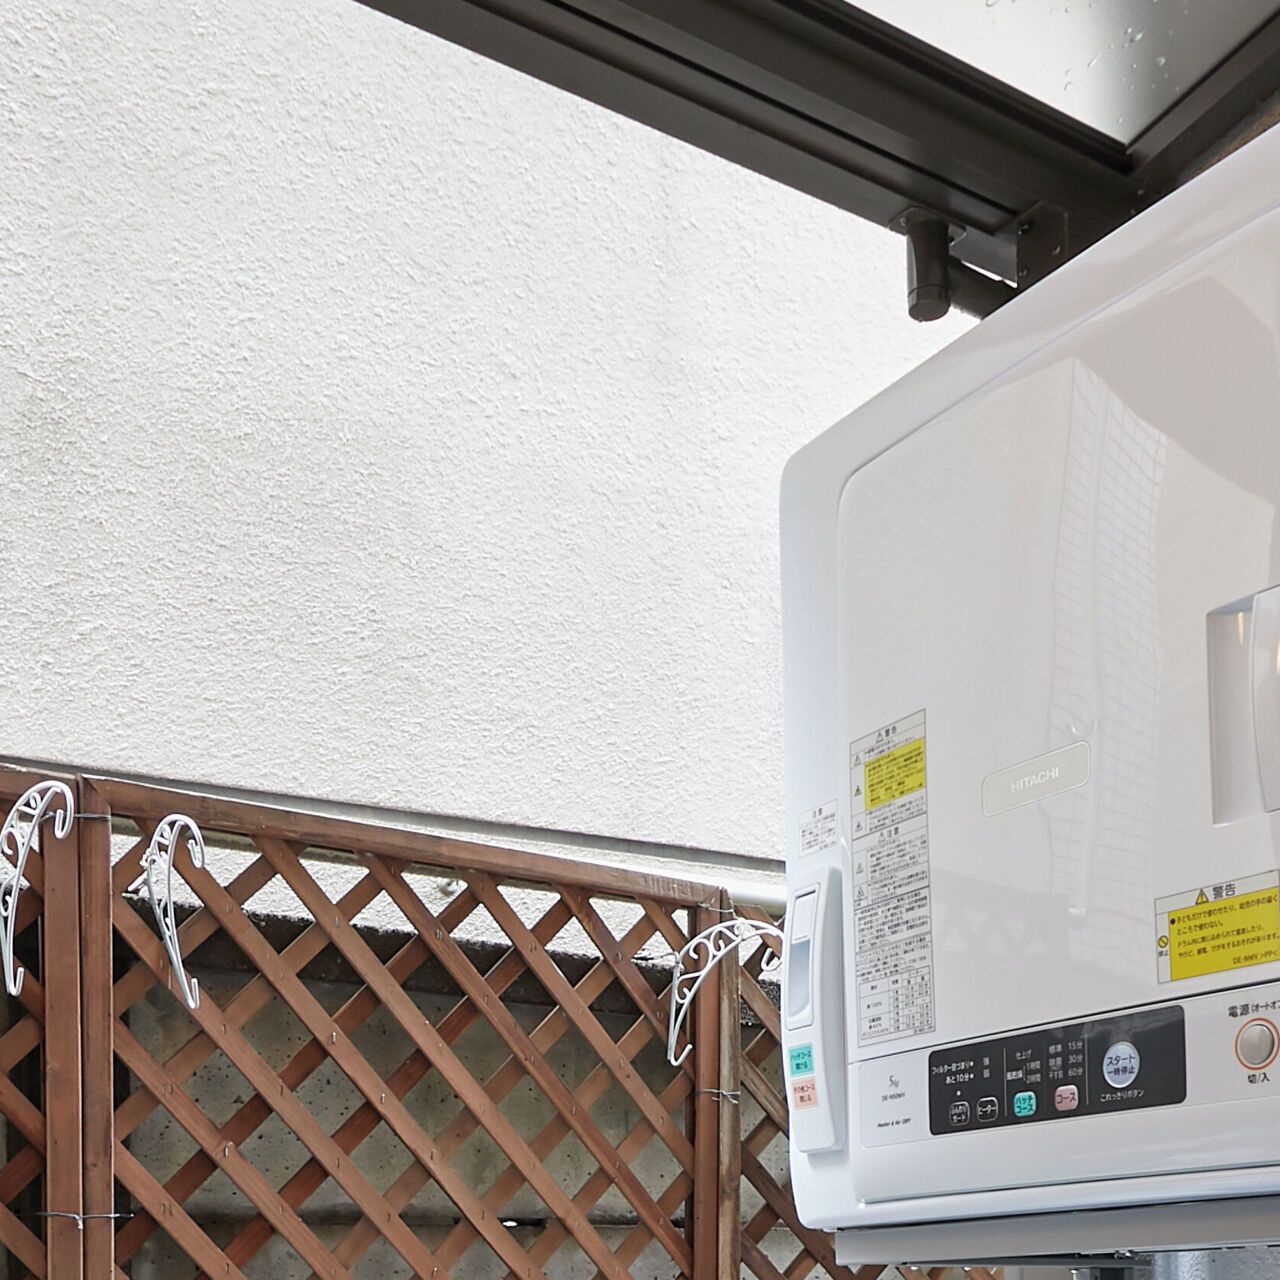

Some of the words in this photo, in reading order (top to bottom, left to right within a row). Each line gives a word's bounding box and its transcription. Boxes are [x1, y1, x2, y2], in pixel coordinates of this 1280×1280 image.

[1011, 767, 1058, 792] HITACHI
[1213, 883, 1236, 900] 警告
[1107, 1054, 1136, 1067] スタート
[1107, 1065, 1136, 1076] 一時停止
[1247, 1072, 1270, 1084] 切/入
[1015, 1095, 1033, 1105] ハッチ
[1056, 1092, 1078, 1104] コース
[1100, 1089, 1144, 1102] これっきりボタン
[978, 1104, 997, 1115] ヒーター
[1016, 1105, 1034, 1114] コース
